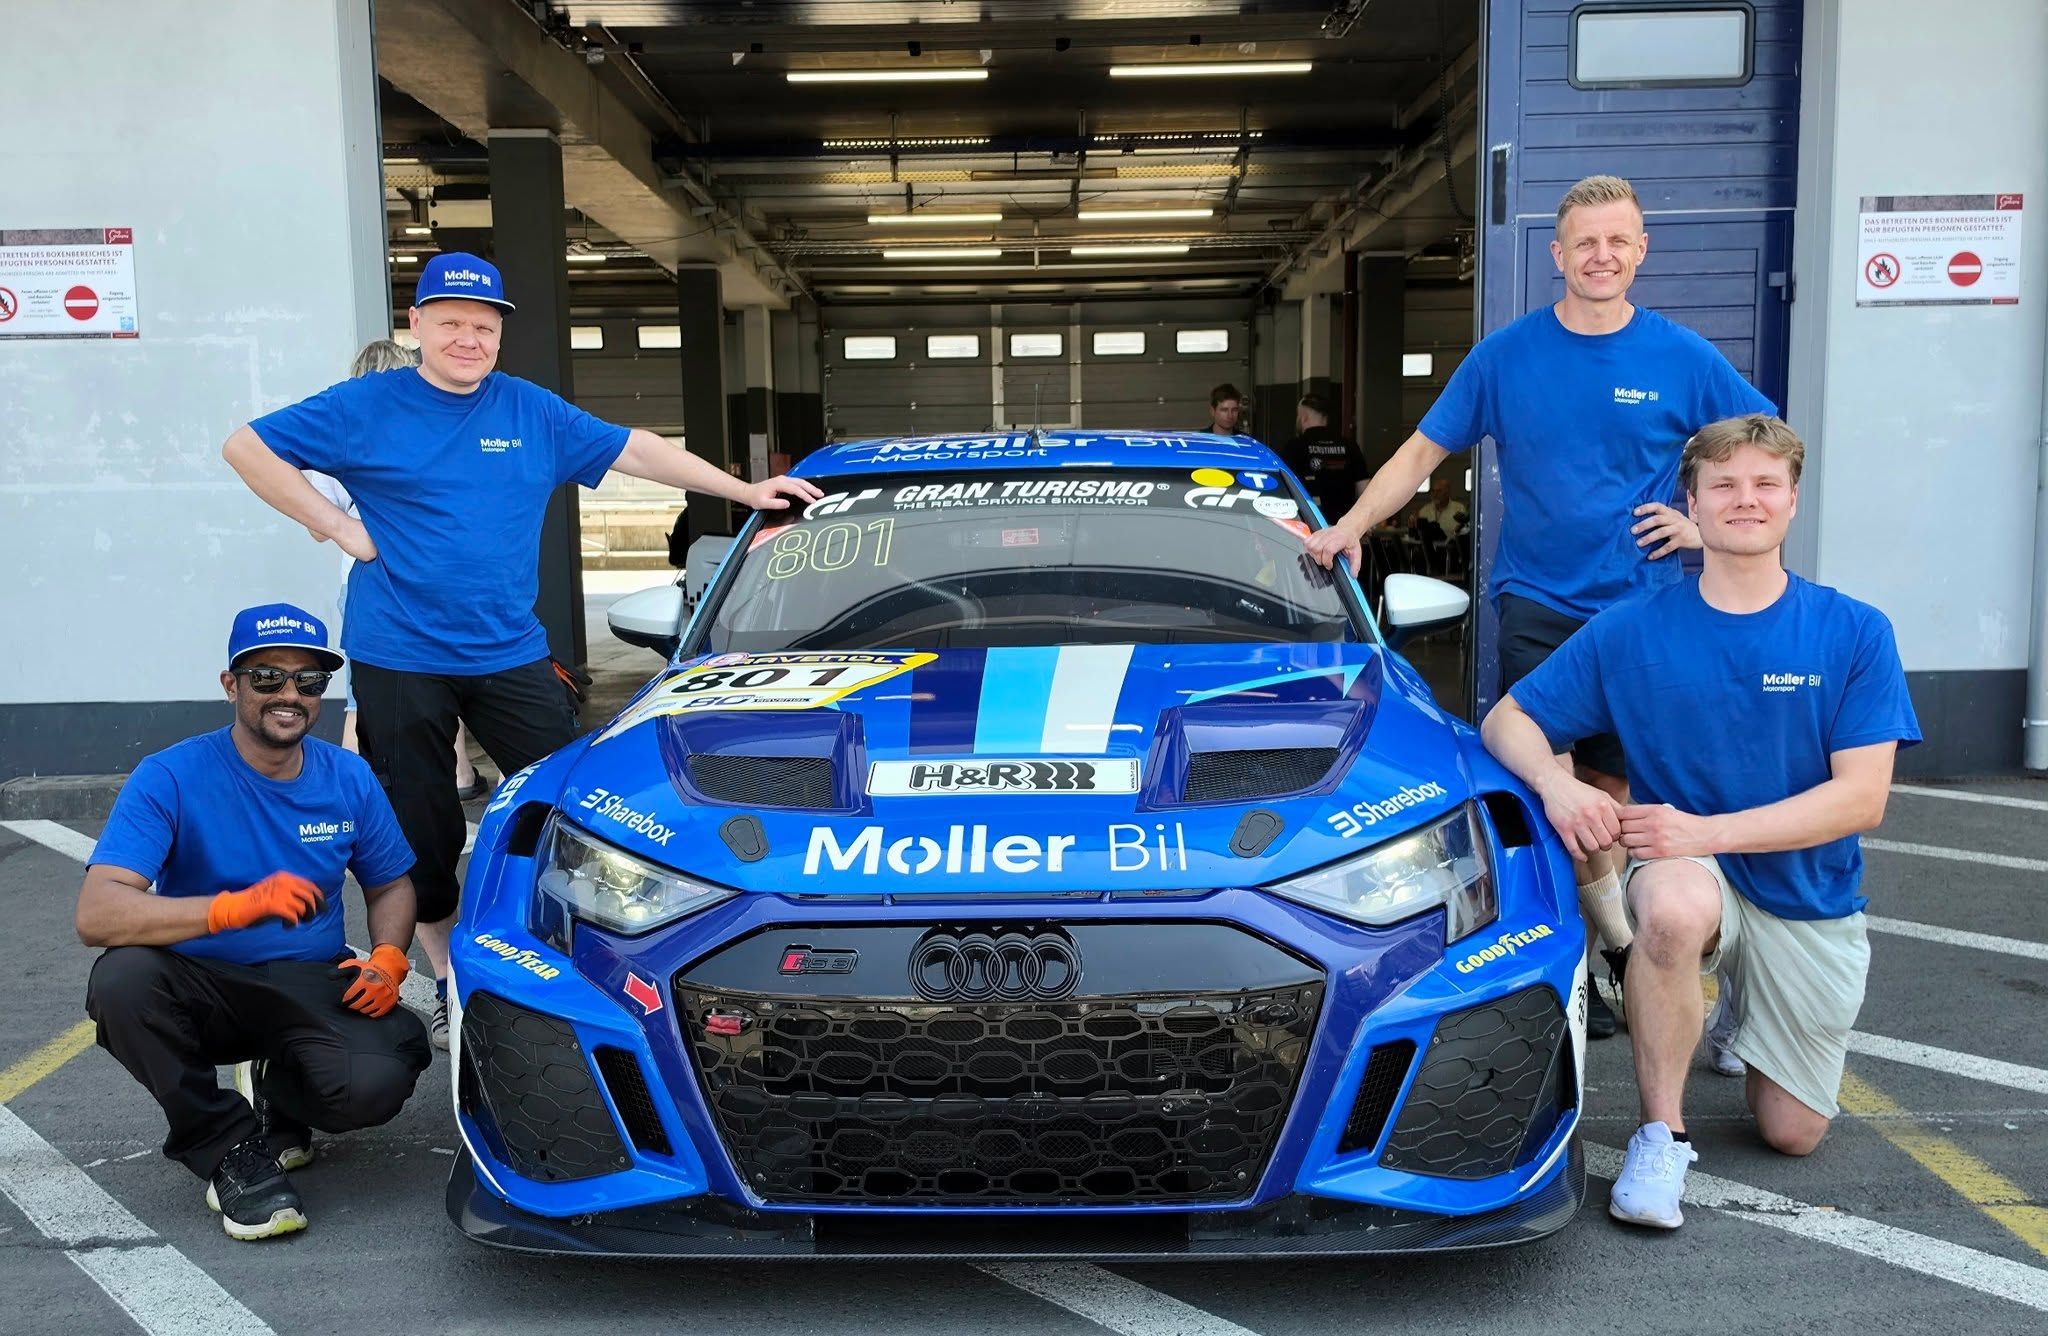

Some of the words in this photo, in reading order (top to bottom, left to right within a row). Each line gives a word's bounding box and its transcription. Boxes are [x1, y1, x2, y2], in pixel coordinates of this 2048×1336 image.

[1881, 217, 1918, 225] BETRETEN
[1919, 217, 1933, 225] DES
[1864, 226, 1881, 234] NUR
[1922, 225, 1963, 233] PERSONEN
[35, 259, 74, 267] PERSONEN
[511, 438, 523, 448] Bil
[870, 448, 1048, 464] Motorsport
[1243, 471, 1269, 489] T
[893, 481, 994, 503] GRAN
[893, 501, 926, 510] THE
[930, 499, 974, 508] REAL
[977, 498, 1047, 506] DRIVING
[1051, 497, 1149, 506] SIMULATOR
[766, 517, 896, 580] 801
[258, 628, 293, 637] Motorsport
[1808, 674, 1821, 687] Bil
[1762, 685, 1796, 693] Motorsport
[1353, 781, 1448, 826] Sharebox
[596, 795, 677, 847] Sharebox
[1108, 822, 1188, 872] Bil
